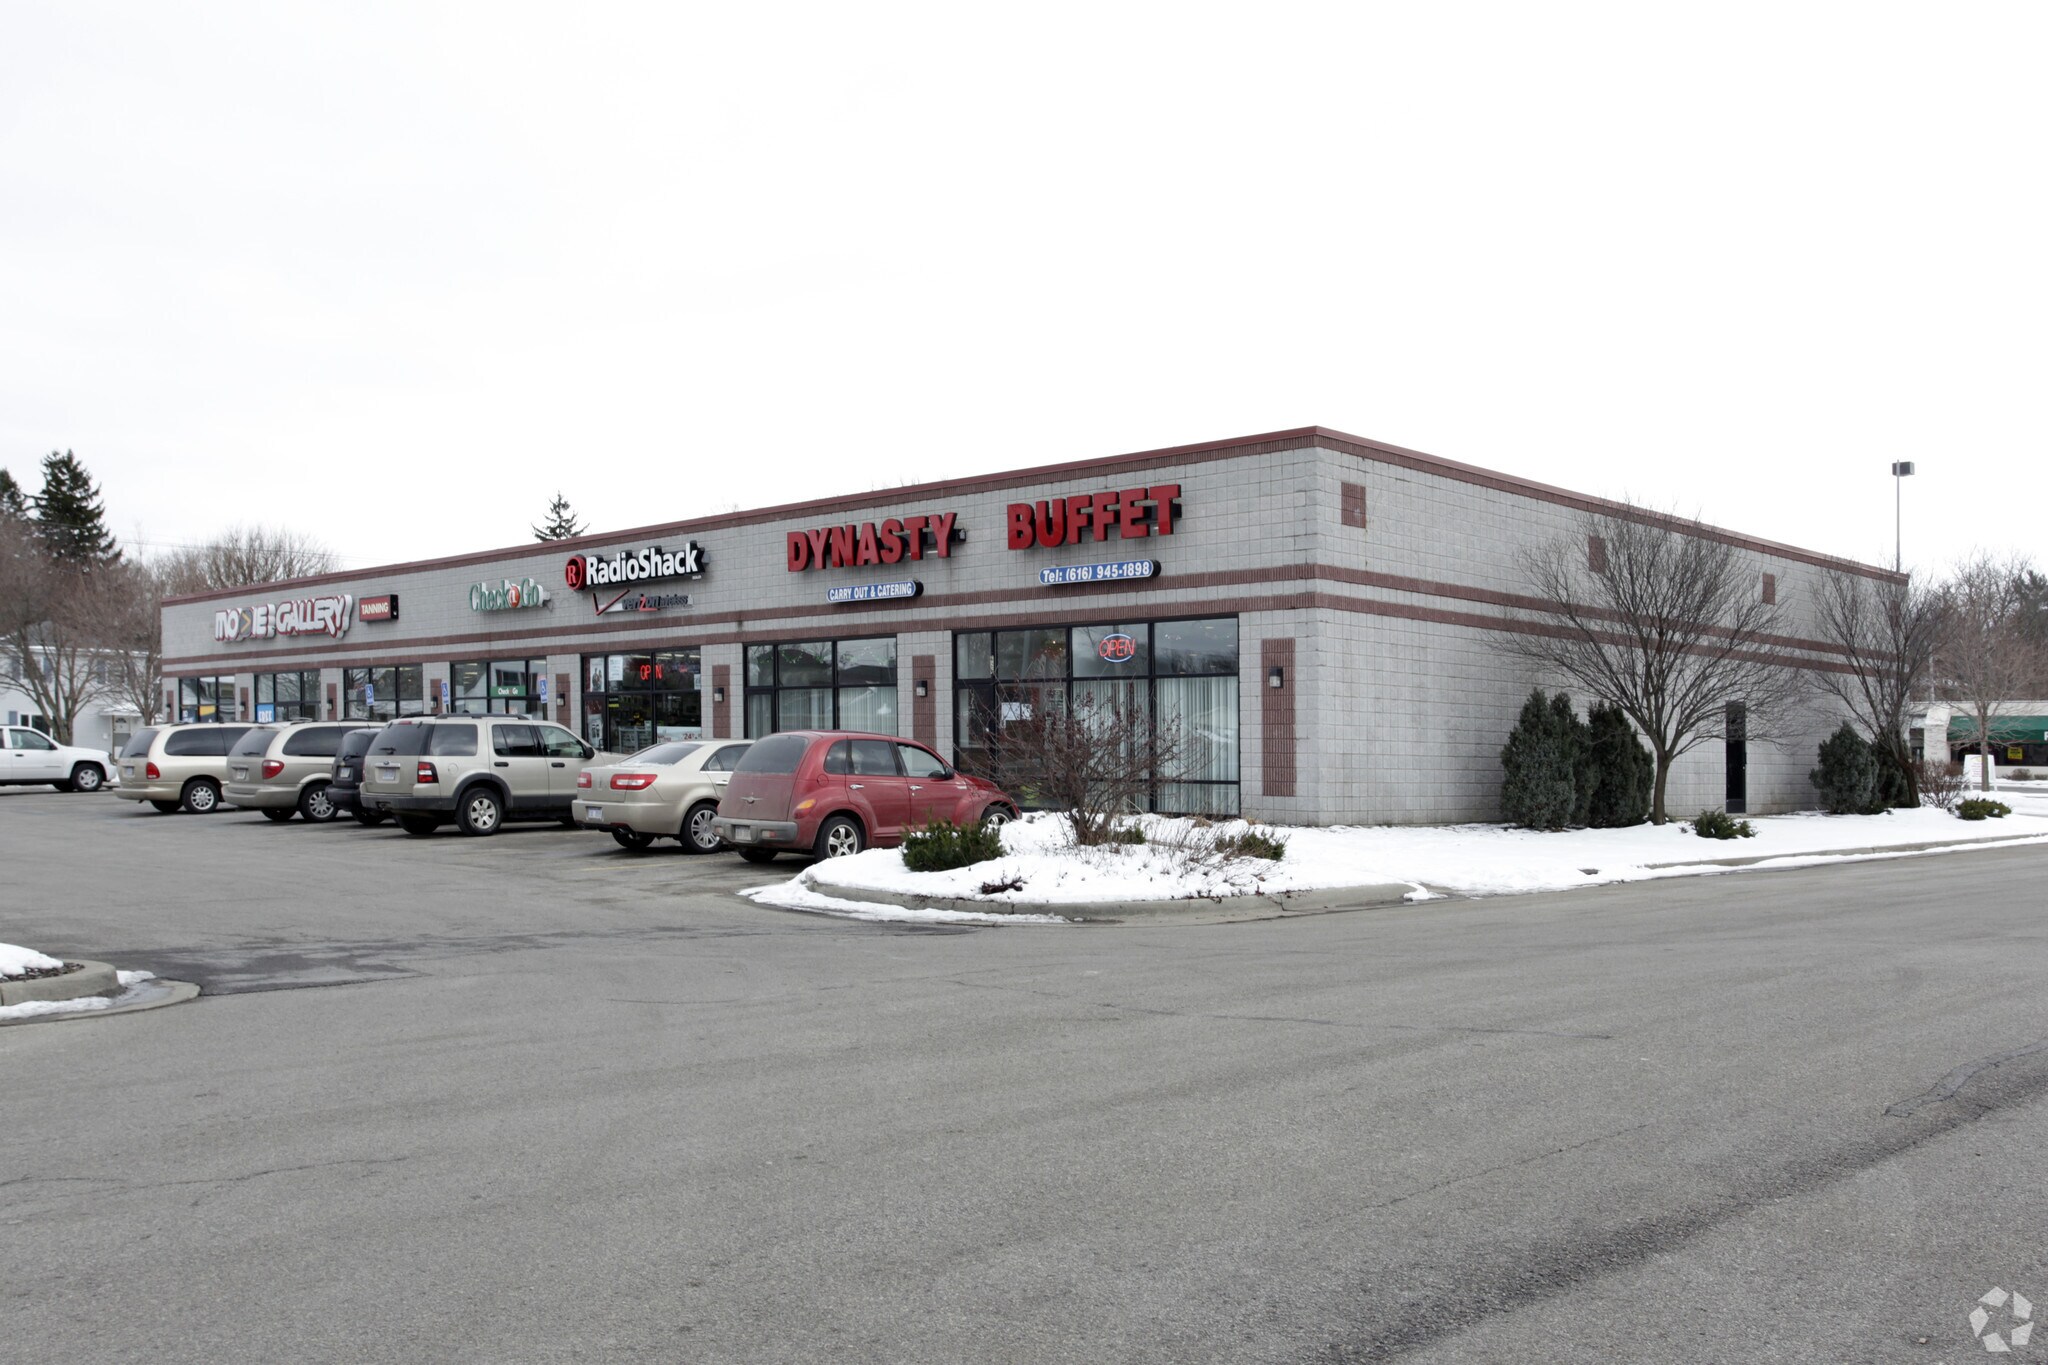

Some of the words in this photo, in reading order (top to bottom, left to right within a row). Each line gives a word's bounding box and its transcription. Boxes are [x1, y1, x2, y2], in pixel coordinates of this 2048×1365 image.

[1007, 484, 1181, 550] BUFFET
[787, 512, 957, 572] DYNASTY
[586, 543, 698, 585] RadioShack
[1042, 569, 1062, 583] Tel:
[1065, 566, 1092, 581] (616)
[1096, 561, 1150, 578] 945-1898
[469, 580, 510, 612] Check
[521, 578, 540, 607] Go
[829, 588, 852, 601] CARRY
[854, 586, 868, 599] OUT
[870, 585, 875, 598] &
[877, 582, 912, 597] CATERING
[276, 596, 349, 639] GALLERY
[361, 602, 389, 615] TANNING
[1099, 638, 1135, 658] OPEN
[640, 664, 663, 680] OPN
